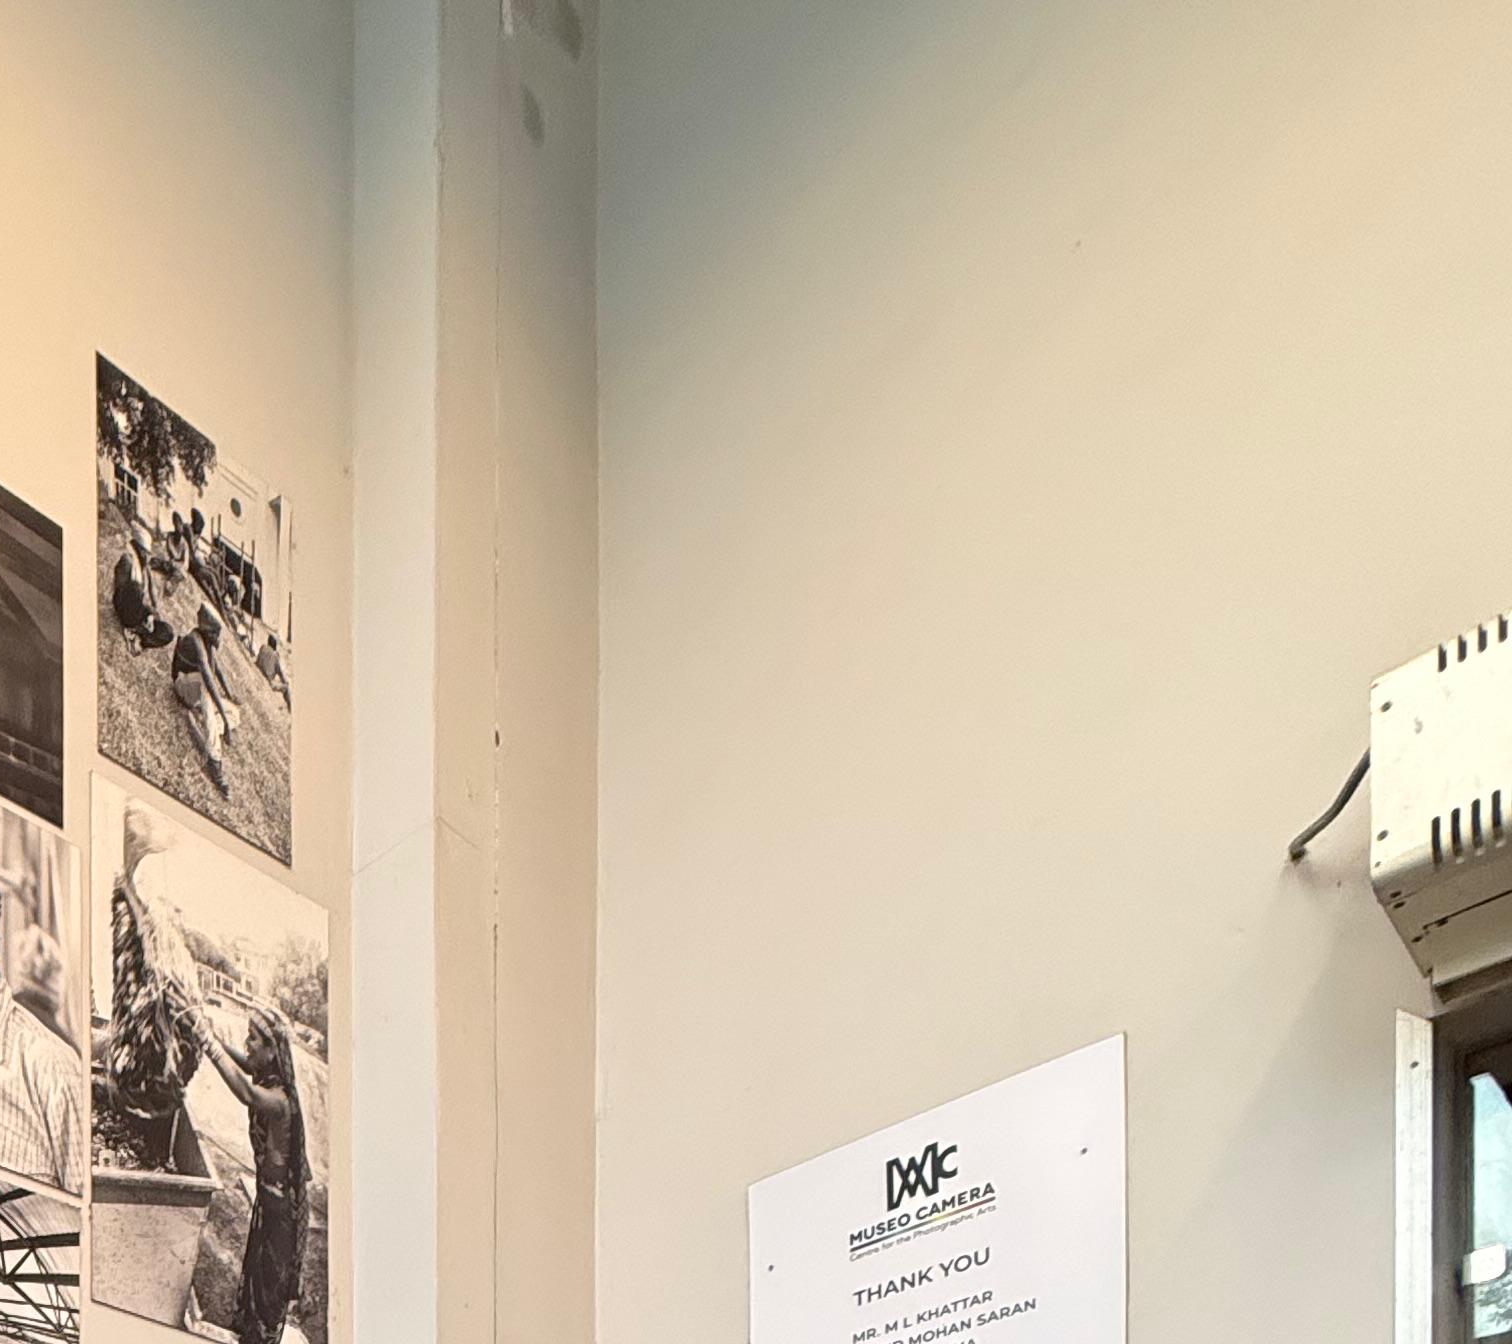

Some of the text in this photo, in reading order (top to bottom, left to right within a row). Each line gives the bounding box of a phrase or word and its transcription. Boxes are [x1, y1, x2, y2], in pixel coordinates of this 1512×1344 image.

[849, 1182, 996, 1246] MUSEO CAMERA
[852, 1246, 990, 1307] THANK YOU
[852, 1290, 993, 1344] MR. M L KHATTAR
[976, 1297, 1037, 1327] SARAN
